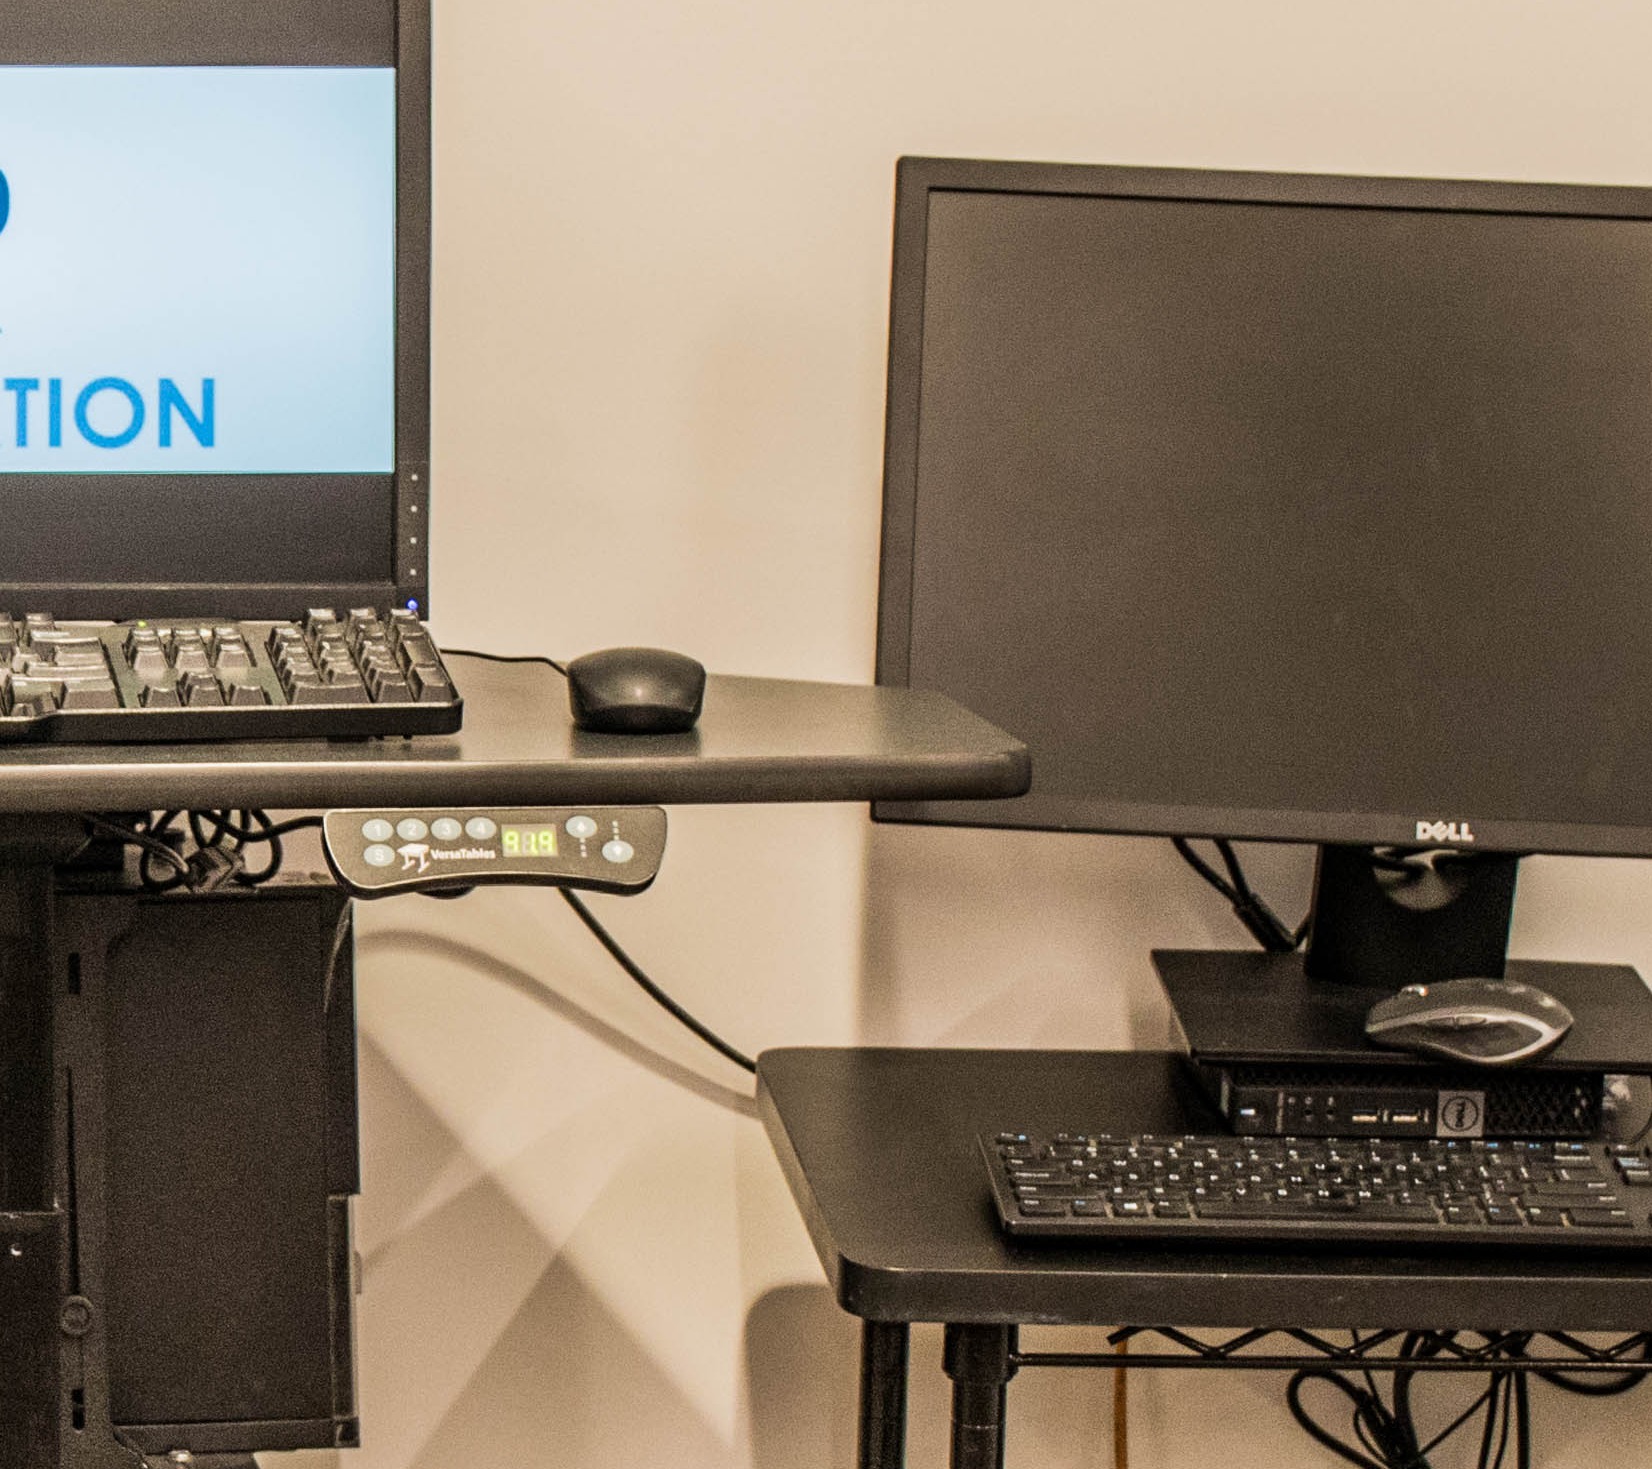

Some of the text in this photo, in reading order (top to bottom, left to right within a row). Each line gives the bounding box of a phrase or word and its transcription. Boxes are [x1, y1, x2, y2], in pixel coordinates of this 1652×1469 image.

[374, 824, 383, 838] 1
[407, 823, 417, 838] 2
[442, 823, 452, 837] 3
[476, 822, 486, 836] 4
[1415, 820, 1474, 842] DELL
[430, 849, 496, 861] VersaTables
